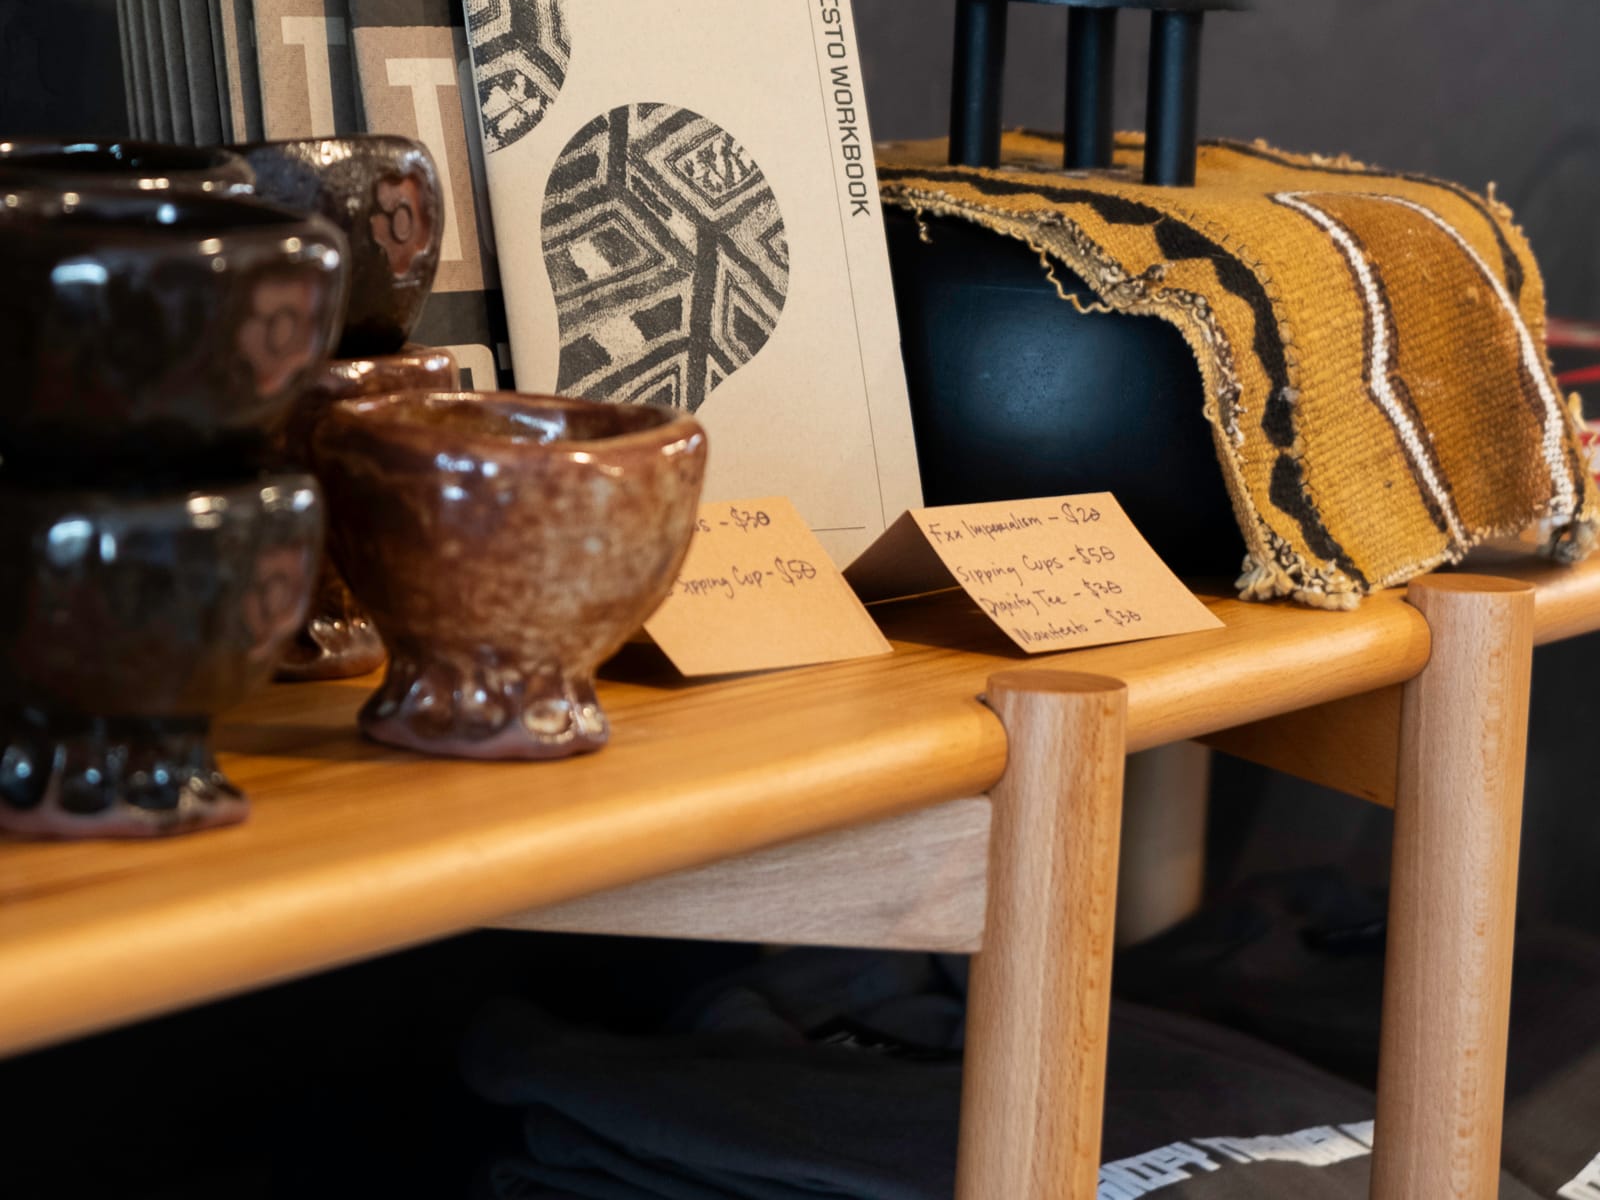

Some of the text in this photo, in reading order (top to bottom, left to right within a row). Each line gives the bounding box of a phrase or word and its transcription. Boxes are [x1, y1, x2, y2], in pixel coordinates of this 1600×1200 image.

[830, 65, 871, 217] WORKBOOK
[731, 565, 763, 589] Cup
[956, 566, 1024, 587] Sipping
[1022, 554, 1064, 574] Cups
[1032, 589, 1067, 608] Tee
